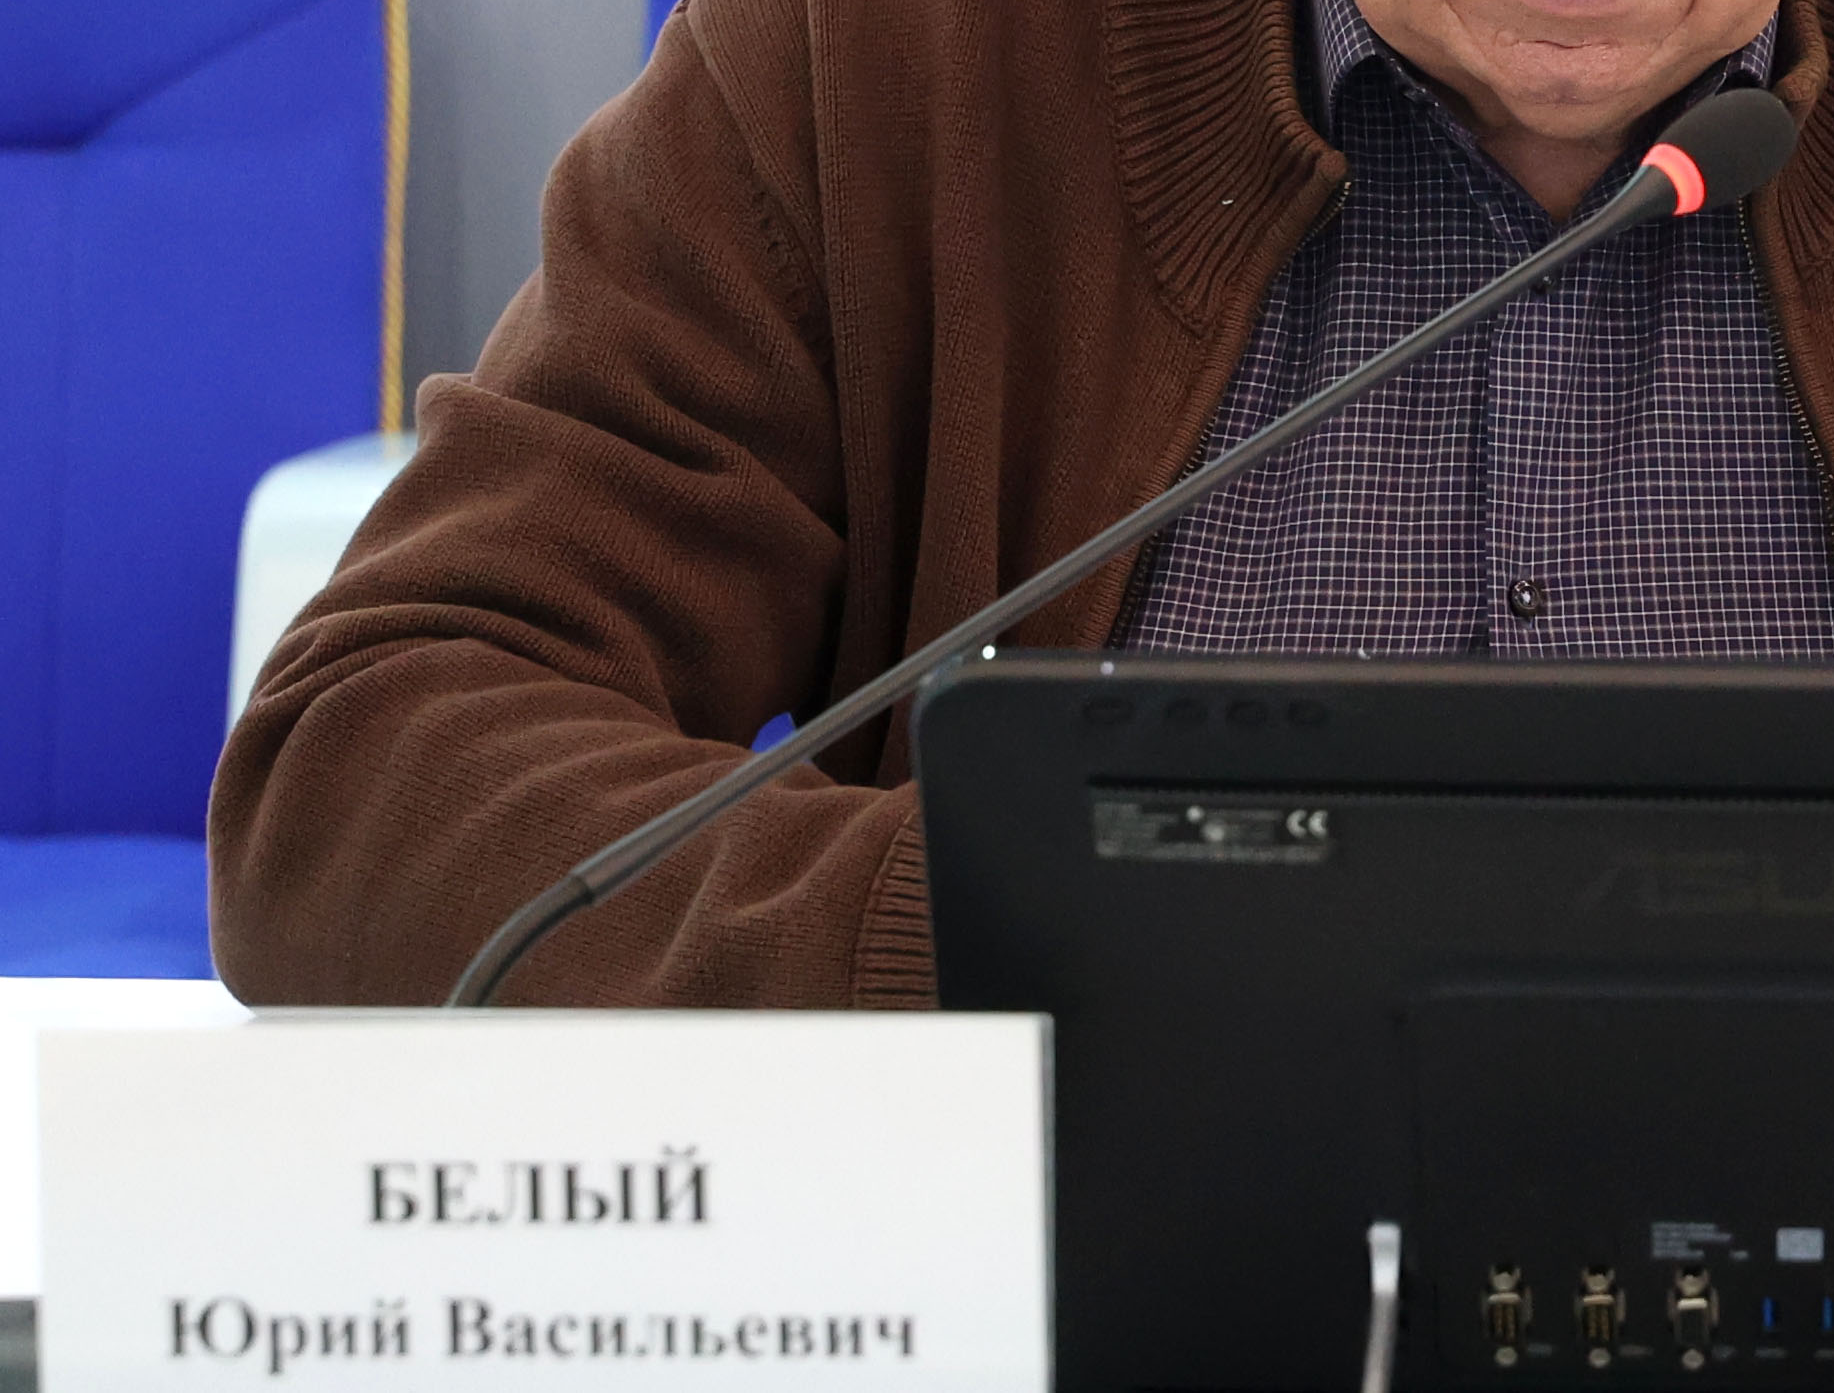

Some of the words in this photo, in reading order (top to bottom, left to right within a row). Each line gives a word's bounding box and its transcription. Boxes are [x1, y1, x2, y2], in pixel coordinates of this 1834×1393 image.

[365, 1145, 712, 1226] БЕЛЫЙ
[166, 1297, 412, 1377] Юрий
[443, 1297, 918, 1358] Васильевич
